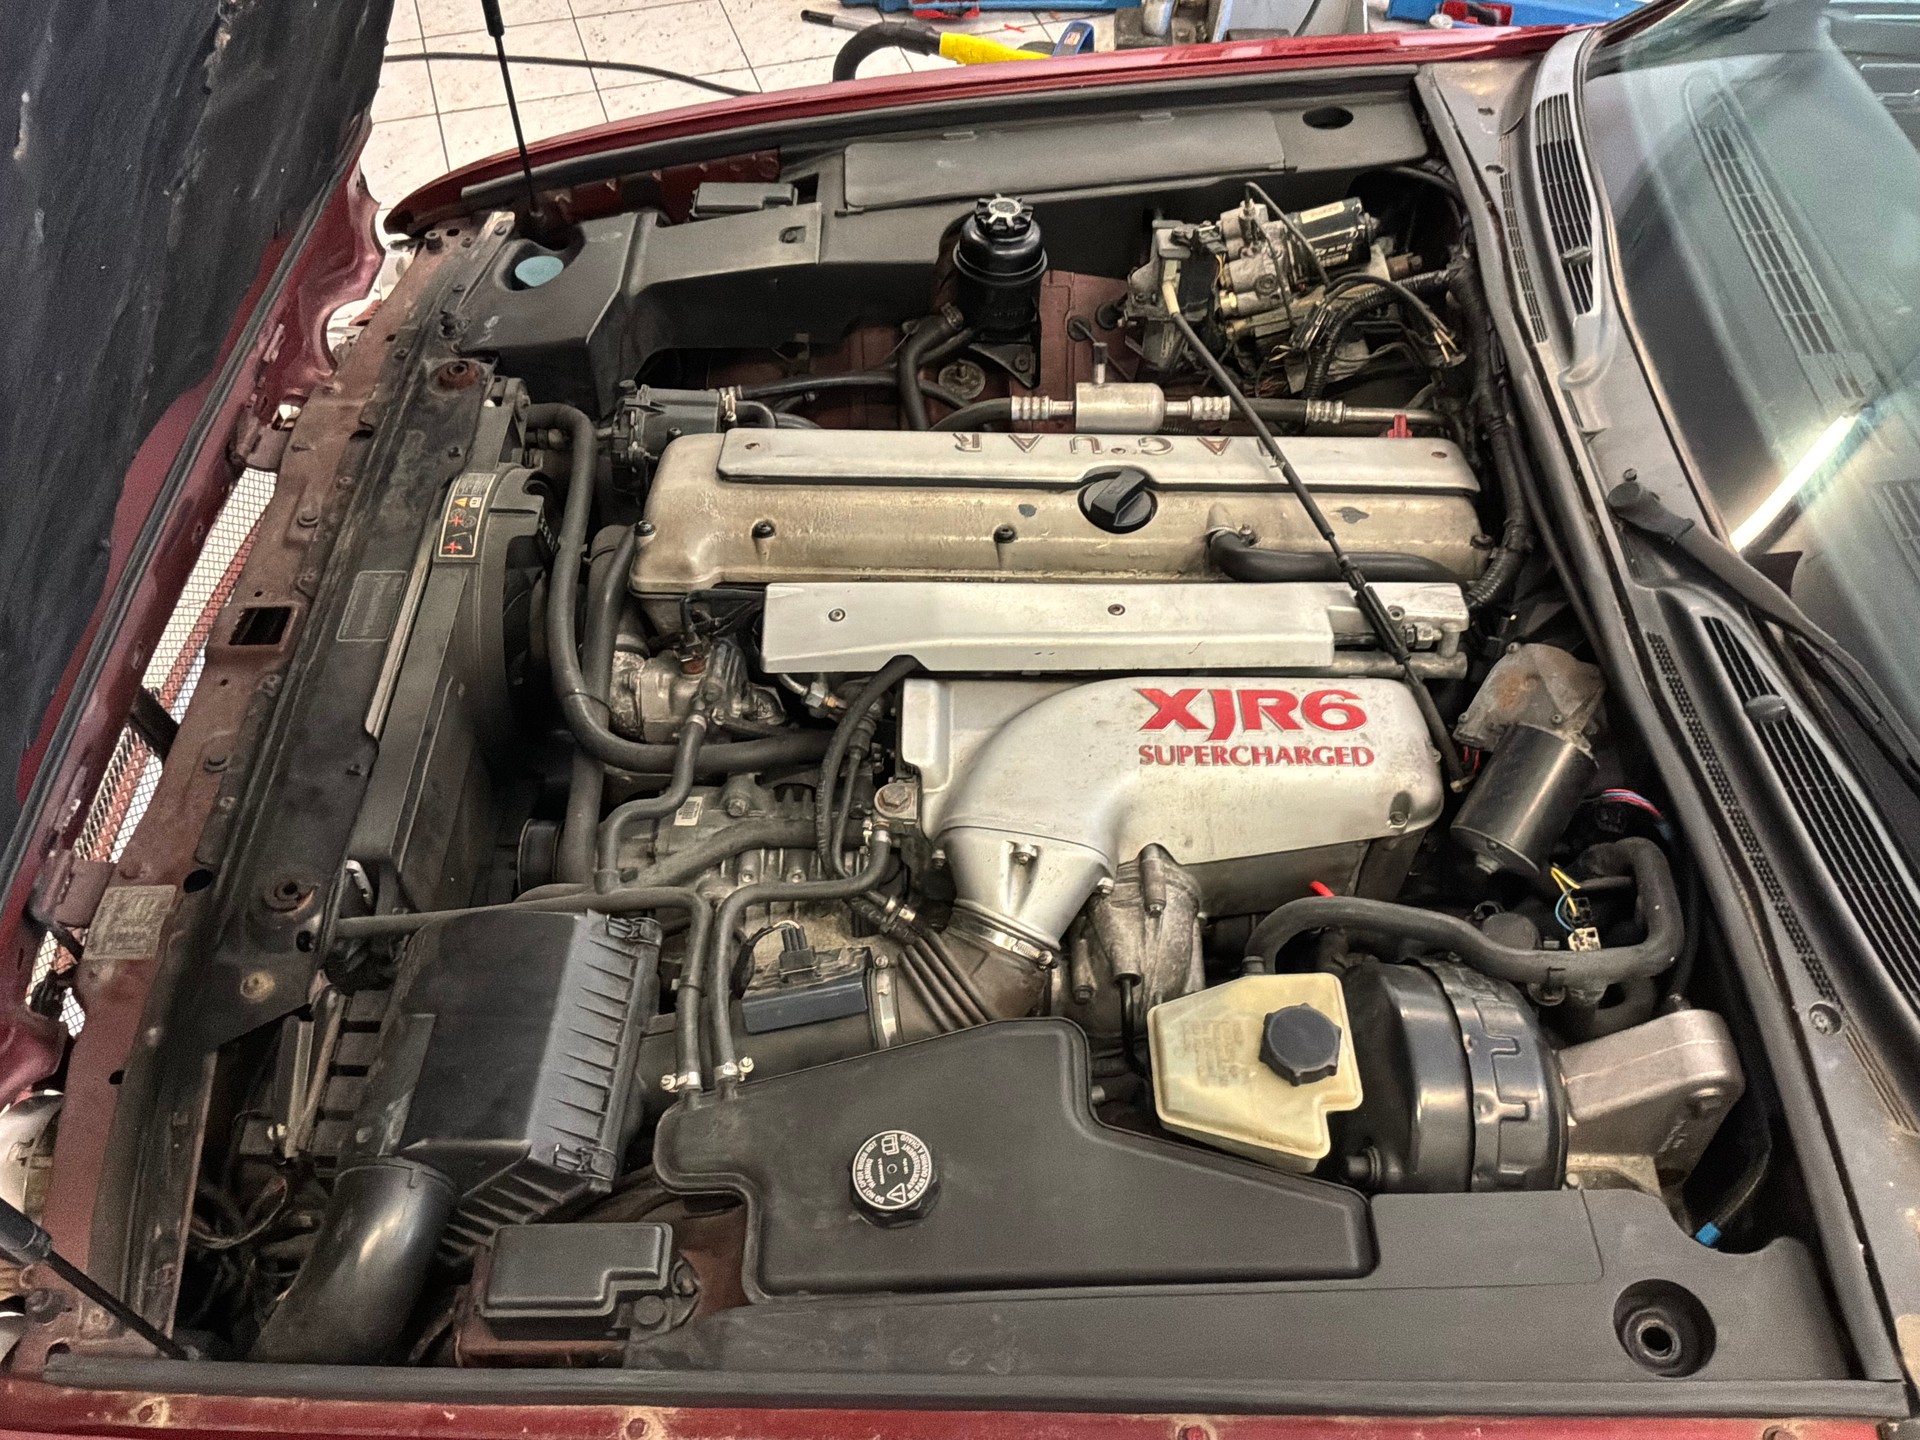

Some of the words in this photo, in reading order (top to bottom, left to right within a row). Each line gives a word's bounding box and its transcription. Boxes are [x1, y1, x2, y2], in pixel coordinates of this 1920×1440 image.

[1134, 688, 1368, 742] XJR6
[1138, 744, 1375, 767] SUPERCHARGED
[865, 1141, 877, 1152] HOT
[857, 1152, 868, 1170] WHEN
[856, 1171, 867, 1188] OPEN
[864, 1158, 876, 1188] WARNING
[863, 1187, 876, 1199] NOT
[914, 1178, 926, 1191] PAS
[874, 1195, 884, 1204] DO
